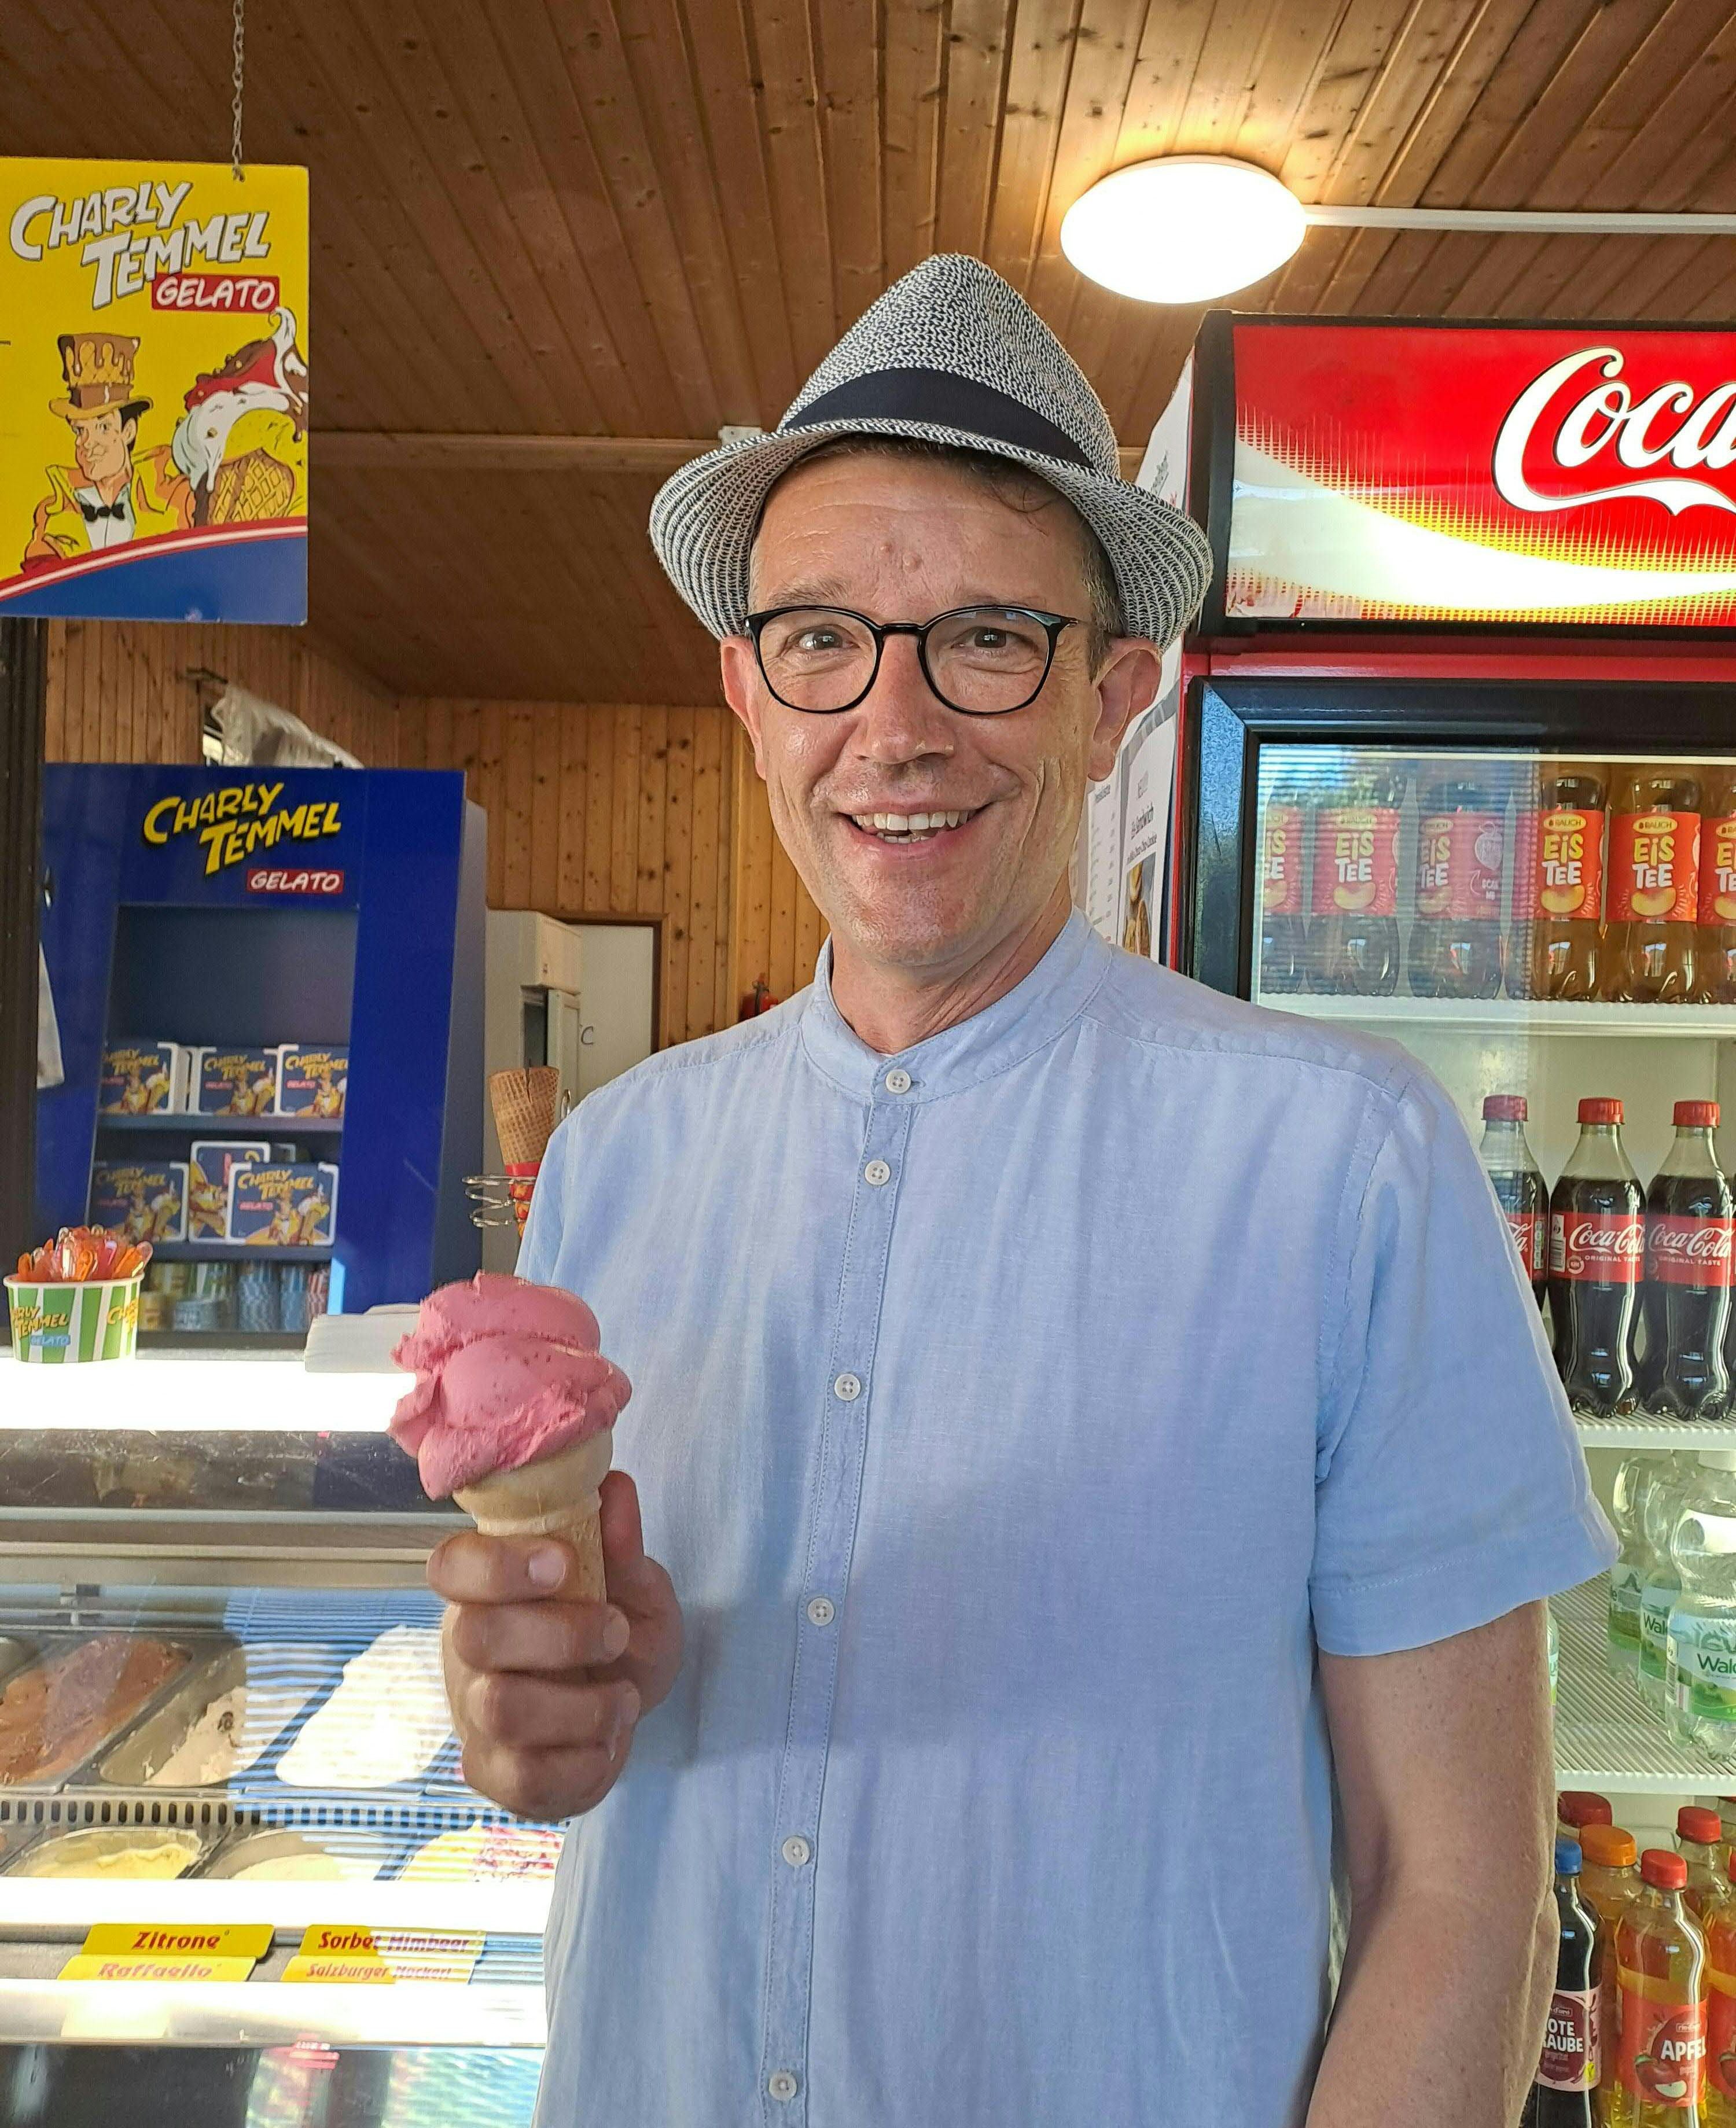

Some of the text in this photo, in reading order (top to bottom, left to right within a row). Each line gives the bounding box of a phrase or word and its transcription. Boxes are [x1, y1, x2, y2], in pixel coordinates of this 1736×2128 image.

[10, 181, 192, 260] CHARLY
[82, 211, 271, 309] TEMMEL
[156, 277, 276, 309] GELATO
[144, 782, 285, 845] CHARLY
[200, 802, 342, 875] TEMMEL
[249, 870, 340, 892] GELATO
[1334, 857, 1373, 883] TEE
[1542, 860, 1583, 886] TEE
[1632, 863, 1674, 889] TEE
[131, 1931, 221, 1950] Zitrone
[319, 1931, 382, 1950] Sorbet
[97, 1963, 213, 1978] Raffaello
[306, 1963, 389, 1978] Salzburger
[1547, 2018, 1575, 2037] OTE
